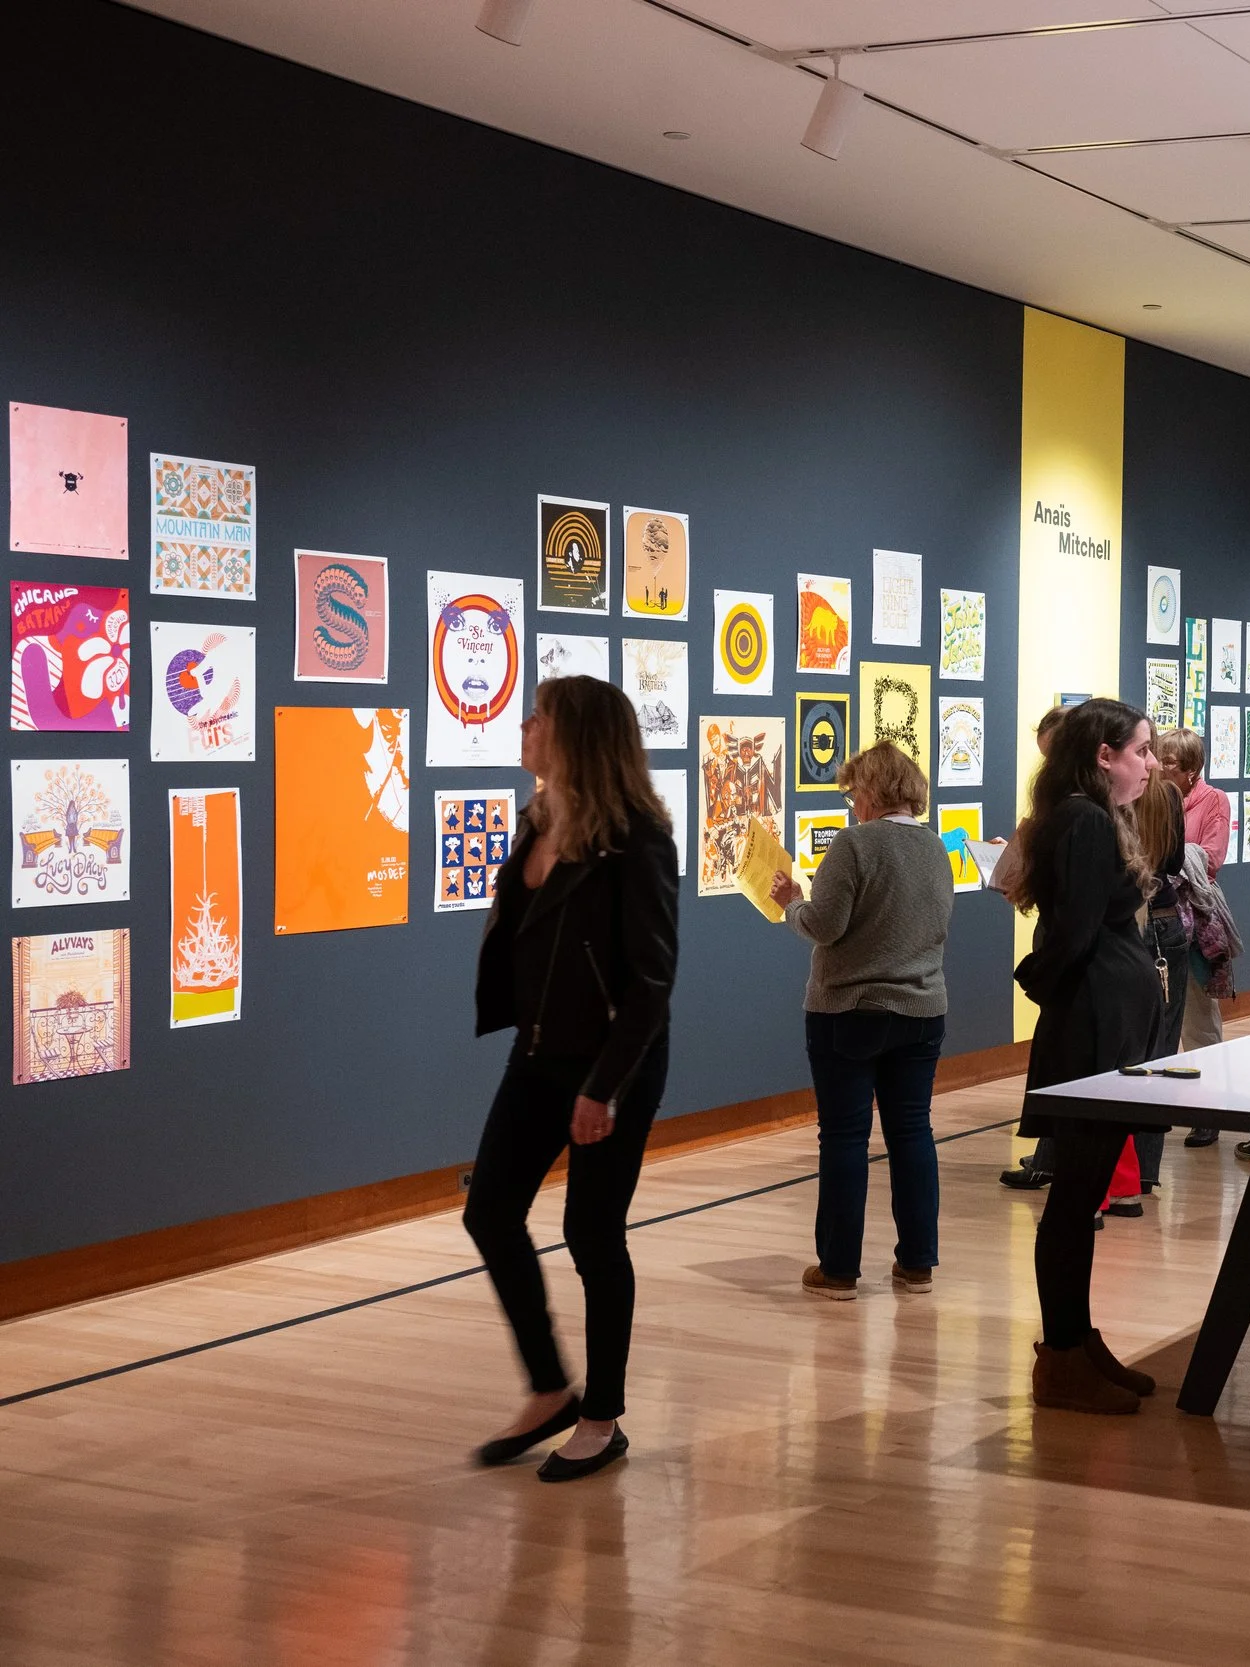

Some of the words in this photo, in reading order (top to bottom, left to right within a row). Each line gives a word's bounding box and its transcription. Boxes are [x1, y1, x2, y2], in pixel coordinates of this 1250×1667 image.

[1034, 501, 1071, 527] Anaïs
[156, 518, 220, 539] MOUNTAIN
[224, 525, 251, 542] MAN
[1059, 532, 1110, 560] Mitchell
[14, 588, 78, 617] CHICANO
[17, 600, 71, 635] BATMAN
[468, 625, 485, 640] St.
[457, 637, 494, 654] Vincent
[51, 936, 94, 955] ALVVAYS
